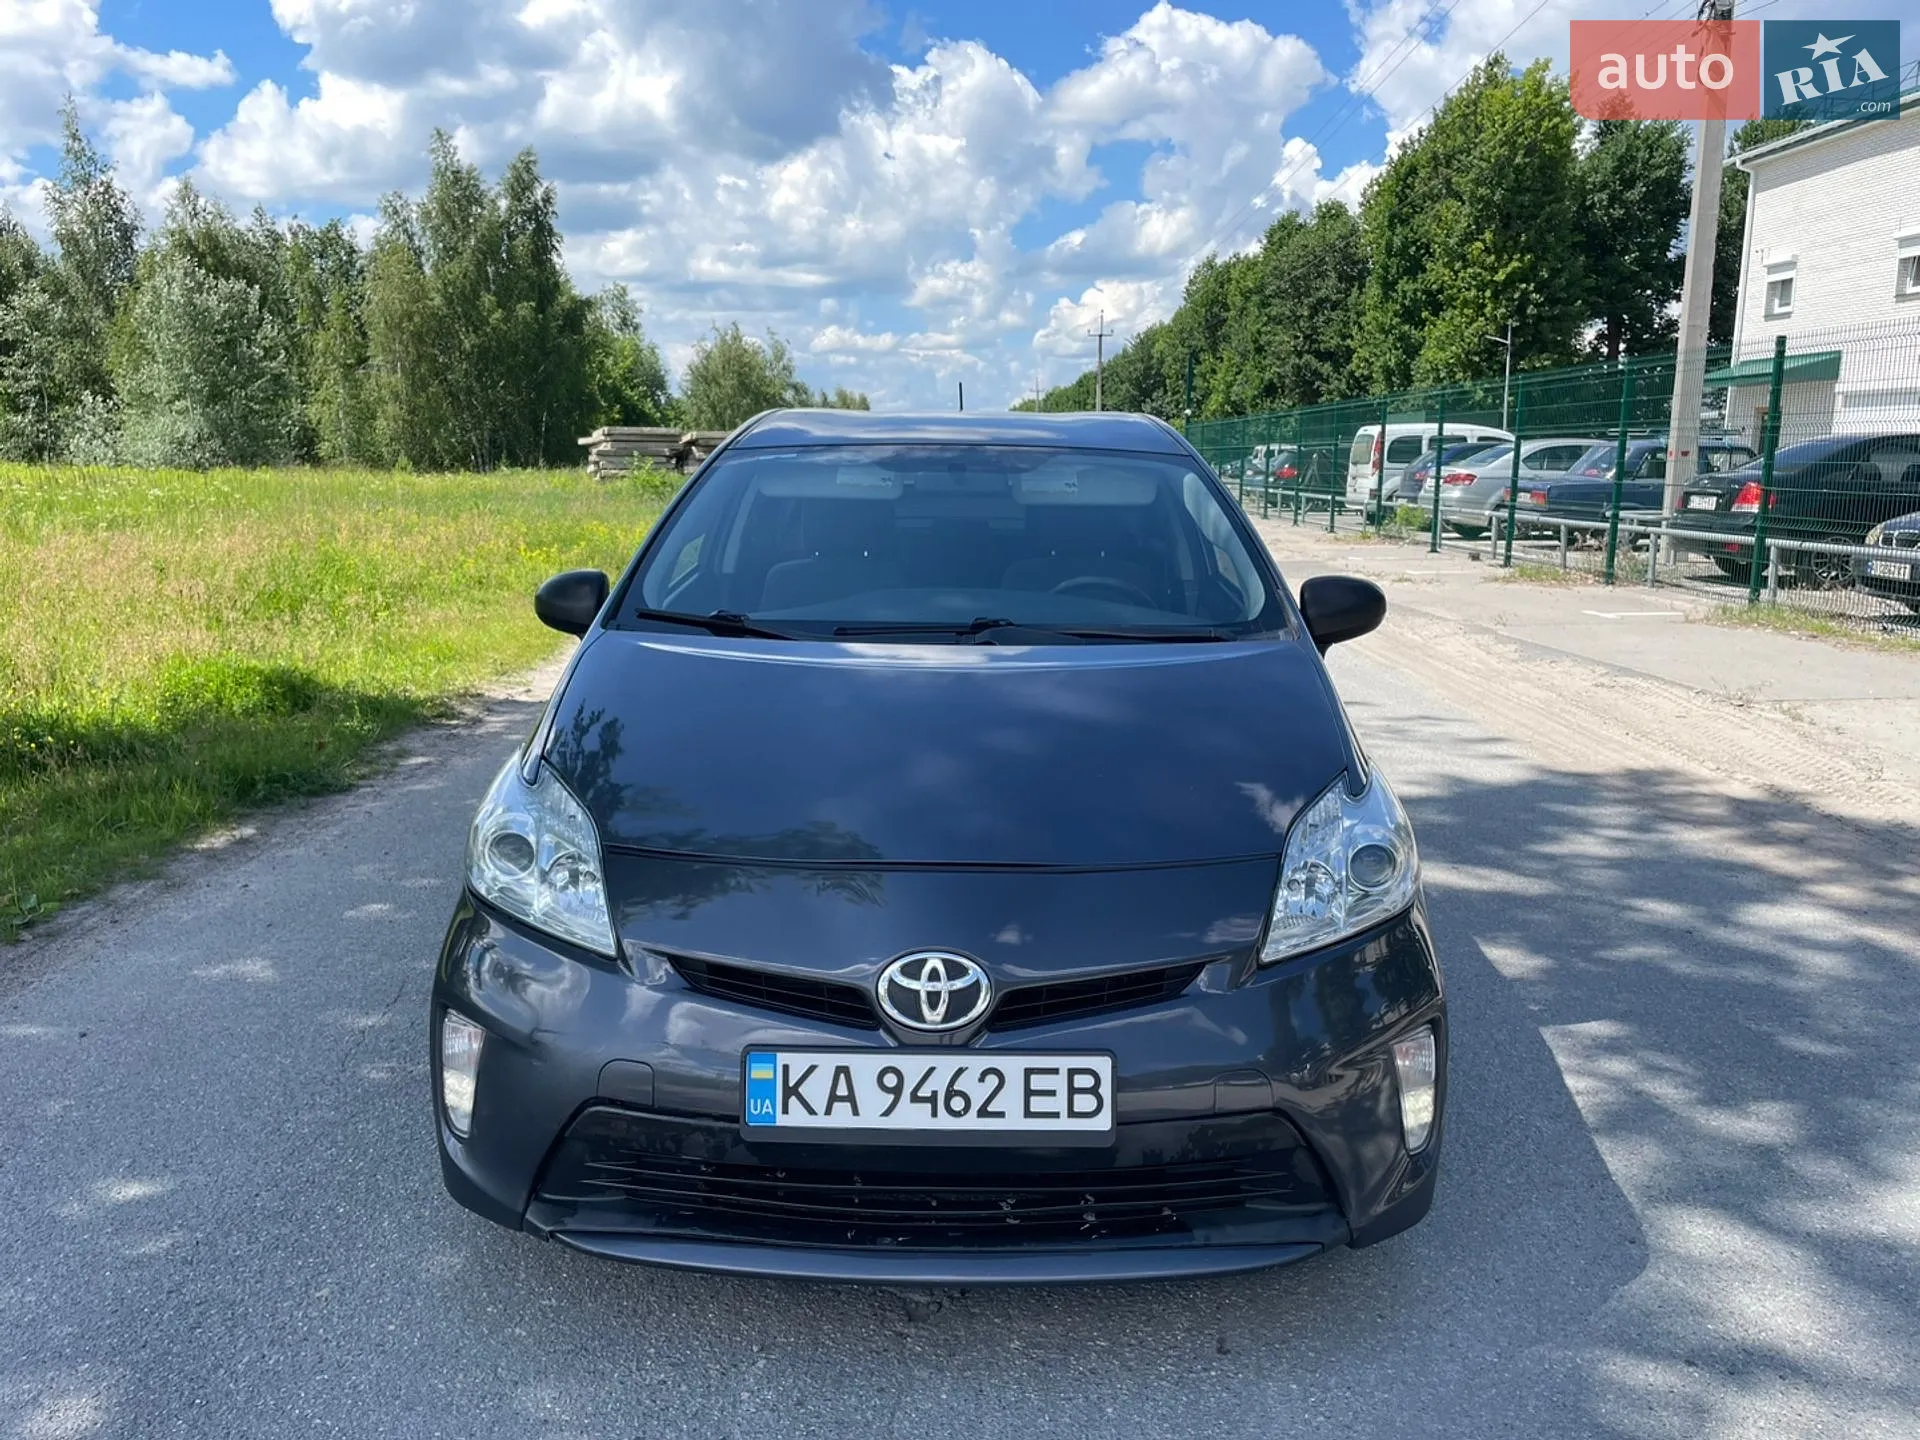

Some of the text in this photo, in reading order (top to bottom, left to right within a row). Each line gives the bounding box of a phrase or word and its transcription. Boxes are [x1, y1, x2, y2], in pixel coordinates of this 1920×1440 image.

[749, 1098, 774, 1116] UA
[781, 1063, 1104, 1119] KA 9462 EB
